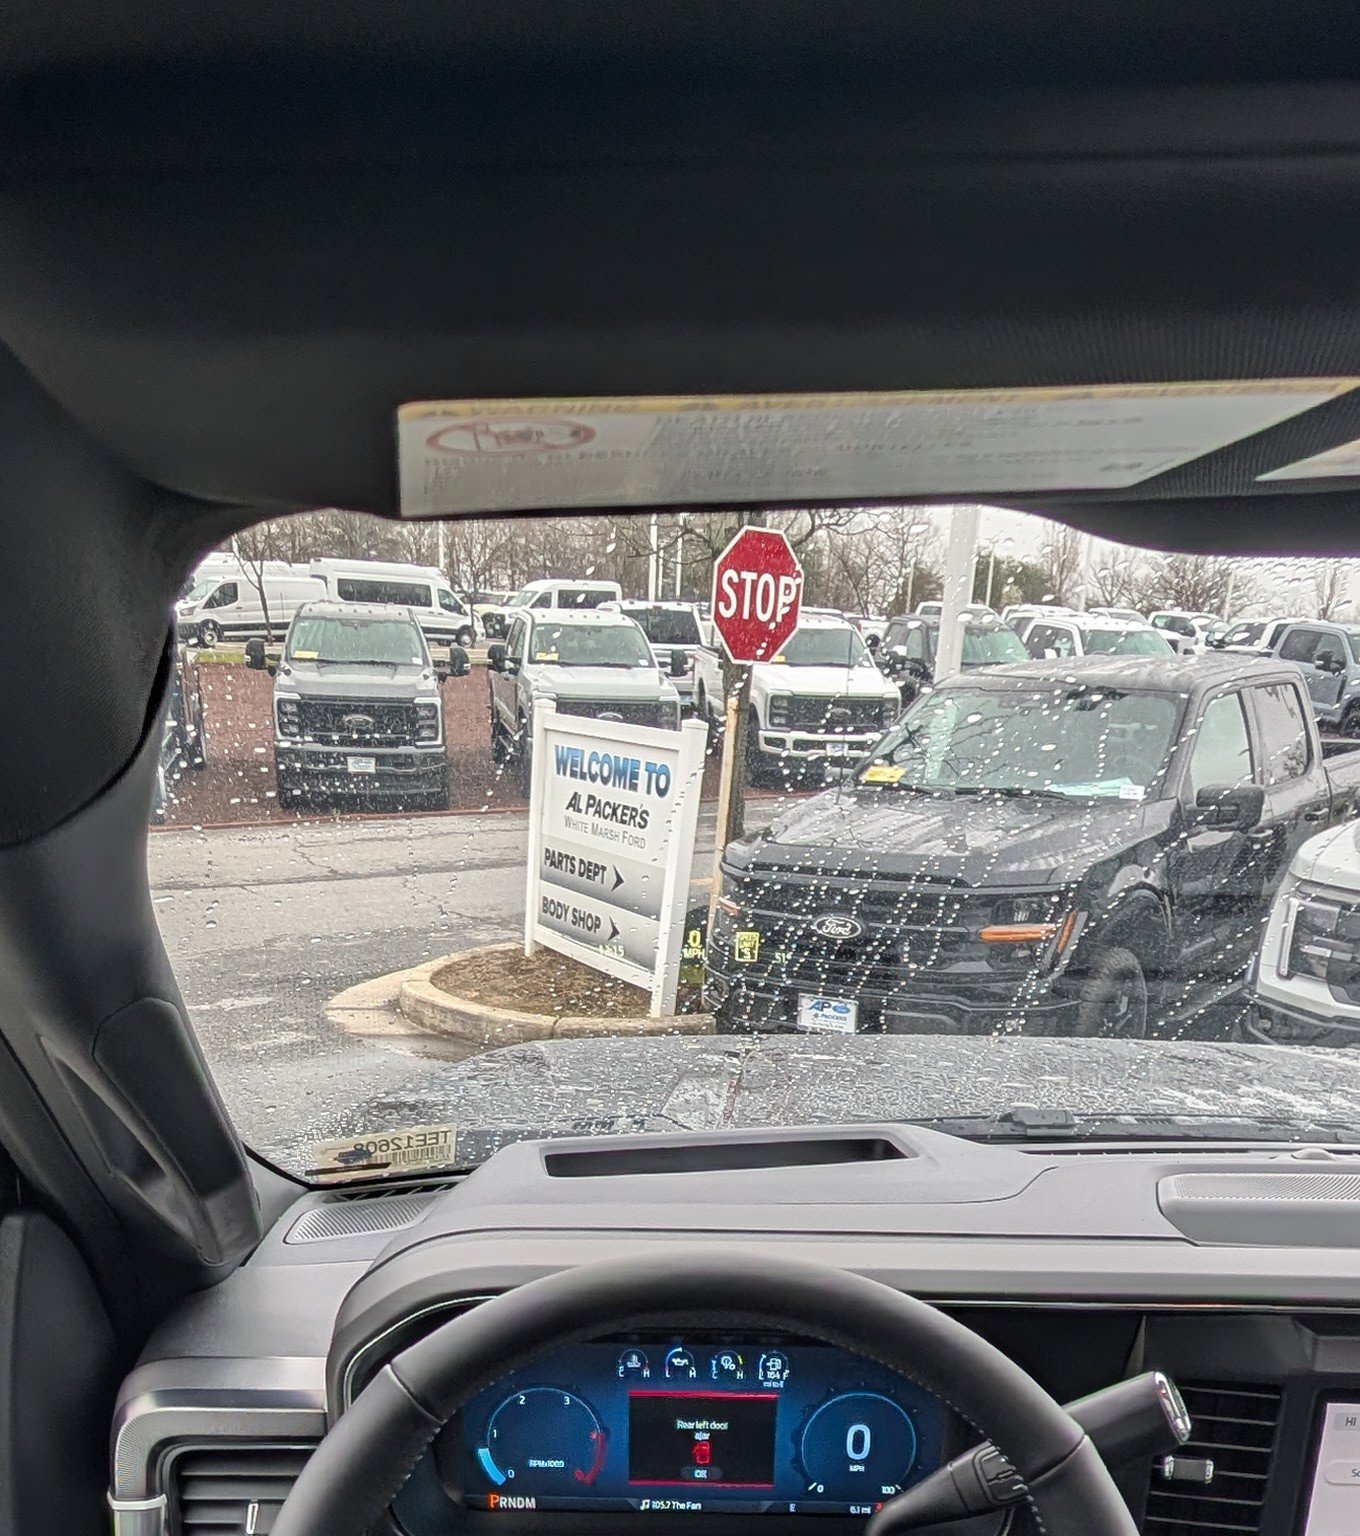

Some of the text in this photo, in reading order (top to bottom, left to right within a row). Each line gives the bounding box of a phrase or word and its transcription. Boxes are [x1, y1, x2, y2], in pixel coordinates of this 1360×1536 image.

[718, 569, 797, 623] STOP
[554, 745, 671, 798] WELCOME TO
[544, 847, 607, 885] PARTS DEPT
[542, 896, 602, 934] BODY SHOP
[820, 918, 853, 936] Ford
[519, 1396, 526, 1405] 2
[563, 1396, 570, 1405] 3
[676, 1420, 729, 1430] Rear left door
[492, 1429, 497, 1438] 1
[694, 1432, 710, 1441] ajar
[846, 1424, 871, 1460] 0
[507, 1470, 515, 1479] 0
[817, 1484, 824, 1493] 0
[671, 1501, 686, 1510] The
[686, 1501, 702, 1510] Fan
